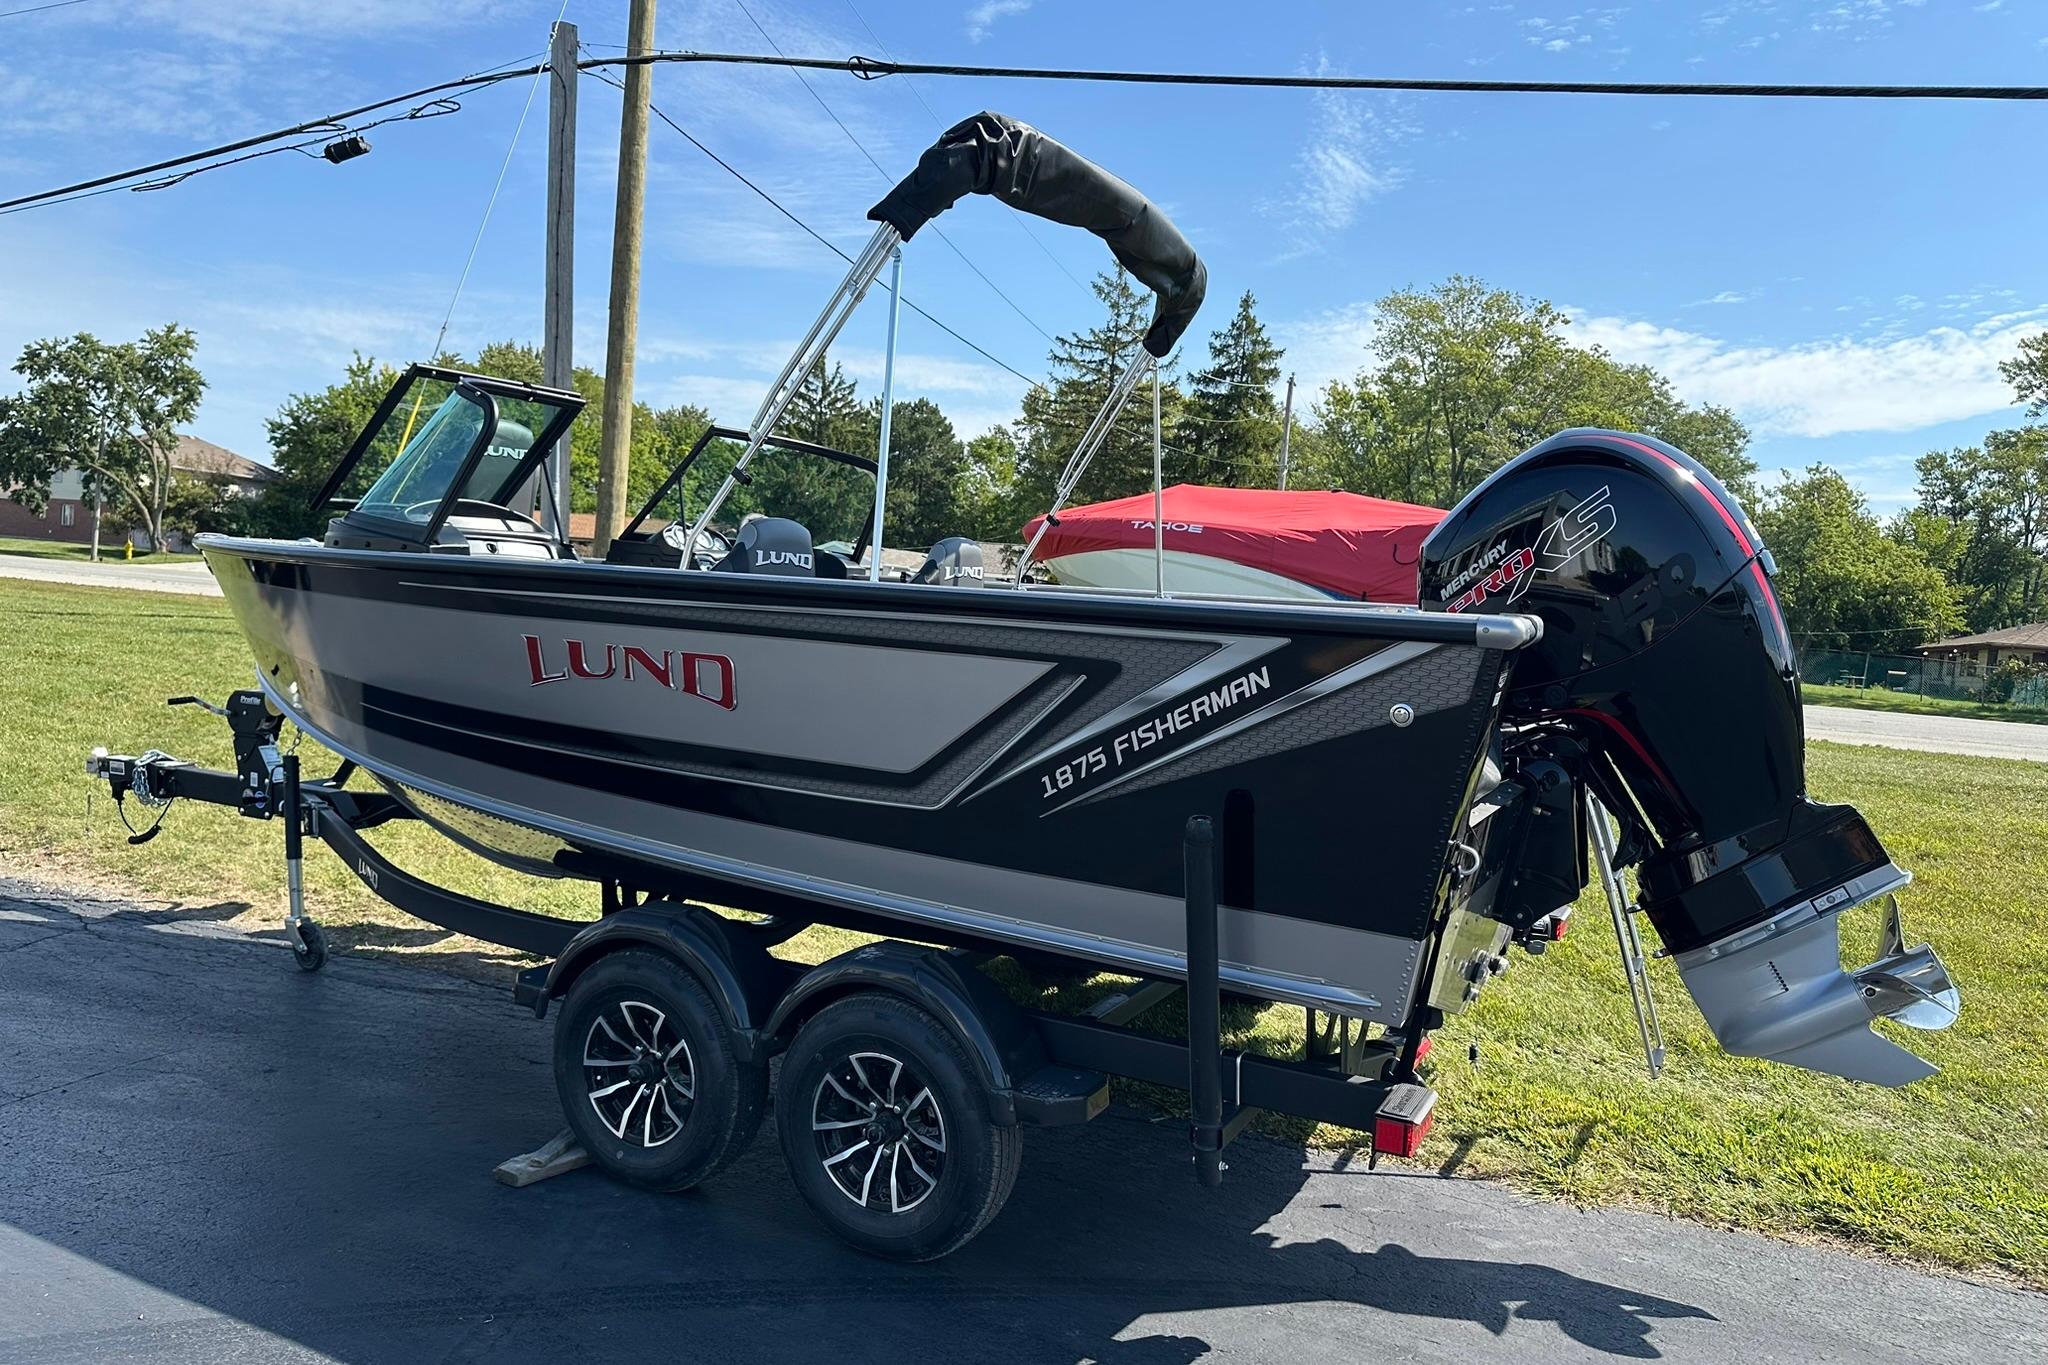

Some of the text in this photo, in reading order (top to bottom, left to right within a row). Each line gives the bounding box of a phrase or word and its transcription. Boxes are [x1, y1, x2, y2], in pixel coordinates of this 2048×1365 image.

[1130, 520, 1205, 534] TAHOE
[1446, 485, 1617, 613] PRO XS
[755, 549, 813, 570] LUND
[943, 566, 984, 581] LUND
[1439, 540, 1509, 602] MERCURY
[520, 633, 738, 711] LUND
[1040, 665, 1271, 799] 1875 FISHERMAN
[358, 857, 378, 890] LUND
